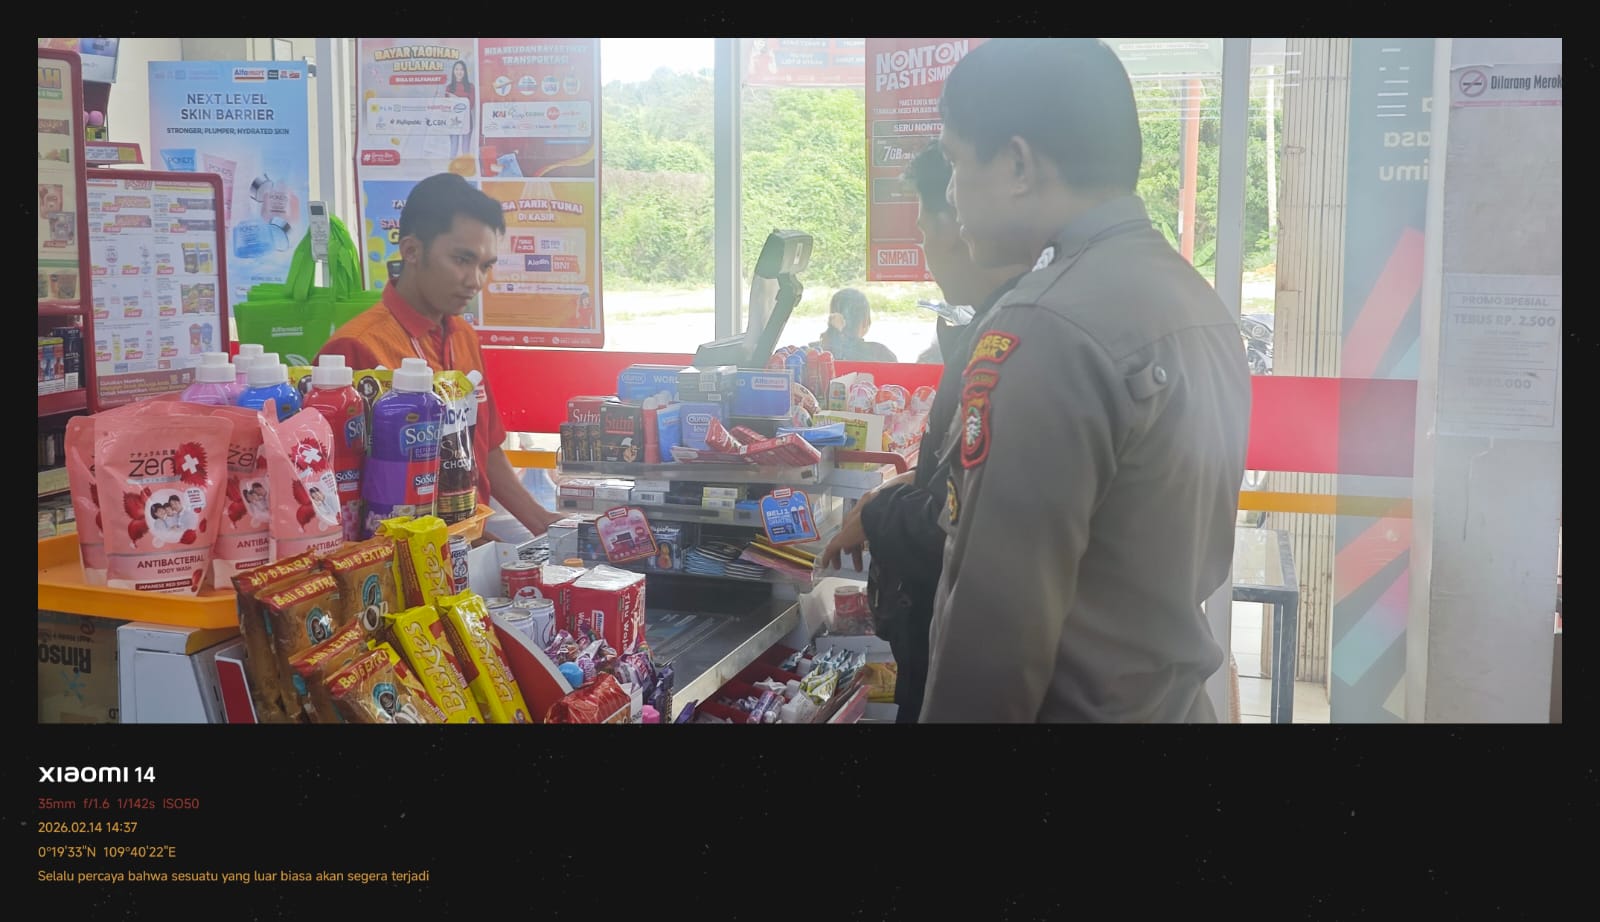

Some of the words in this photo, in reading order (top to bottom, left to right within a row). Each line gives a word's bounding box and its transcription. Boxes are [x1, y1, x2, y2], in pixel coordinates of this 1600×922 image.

[375, 46, 412, 61] BAYAR
[413, 45, 460, 59] TAGIHAN
[876, 40, 968, 74] NONTON
[393, 61, 444, 72] BULANAN
[876, 67, 926, 92] PASTI
[928, 65, 951, 82] SIMP
[1490, 75, 1531, 90] Dilarang
[187, 93, 222, 104] NEXT
[226, 94, 268, 105] LEVEL
[181, 109, 211, 120] SKIN
[216, 109, 274, 120] BARRIER
[167, 127, 204, 135] STRONGER,
[204, 128, 236, 136] PLUMPER,
[894, 123, 914, 132] SERU
[915, 122, 944, 131] NONTO
[502, 201, 516, 211] SA
[519, 200, 548, 209] TARIK
[551, 201, 583, 213] TUNAI
[529, 212, 555, 221] KASIR
[879, 250, 917, 265] SIMPATI
[1462, 296, 1500, 305] PROMO
[654, 375, 680, 384] WORL
[405, 424, 441, 445] SoSo
[128, 457, 177, 478] zen
[237, 539, 268, 549] ANTIBA
[137, 554, 204, 569] ANTIBACTERIAL
[622, 619, 630, 650] Waja
[38, 643, 92, 674] Rinso
